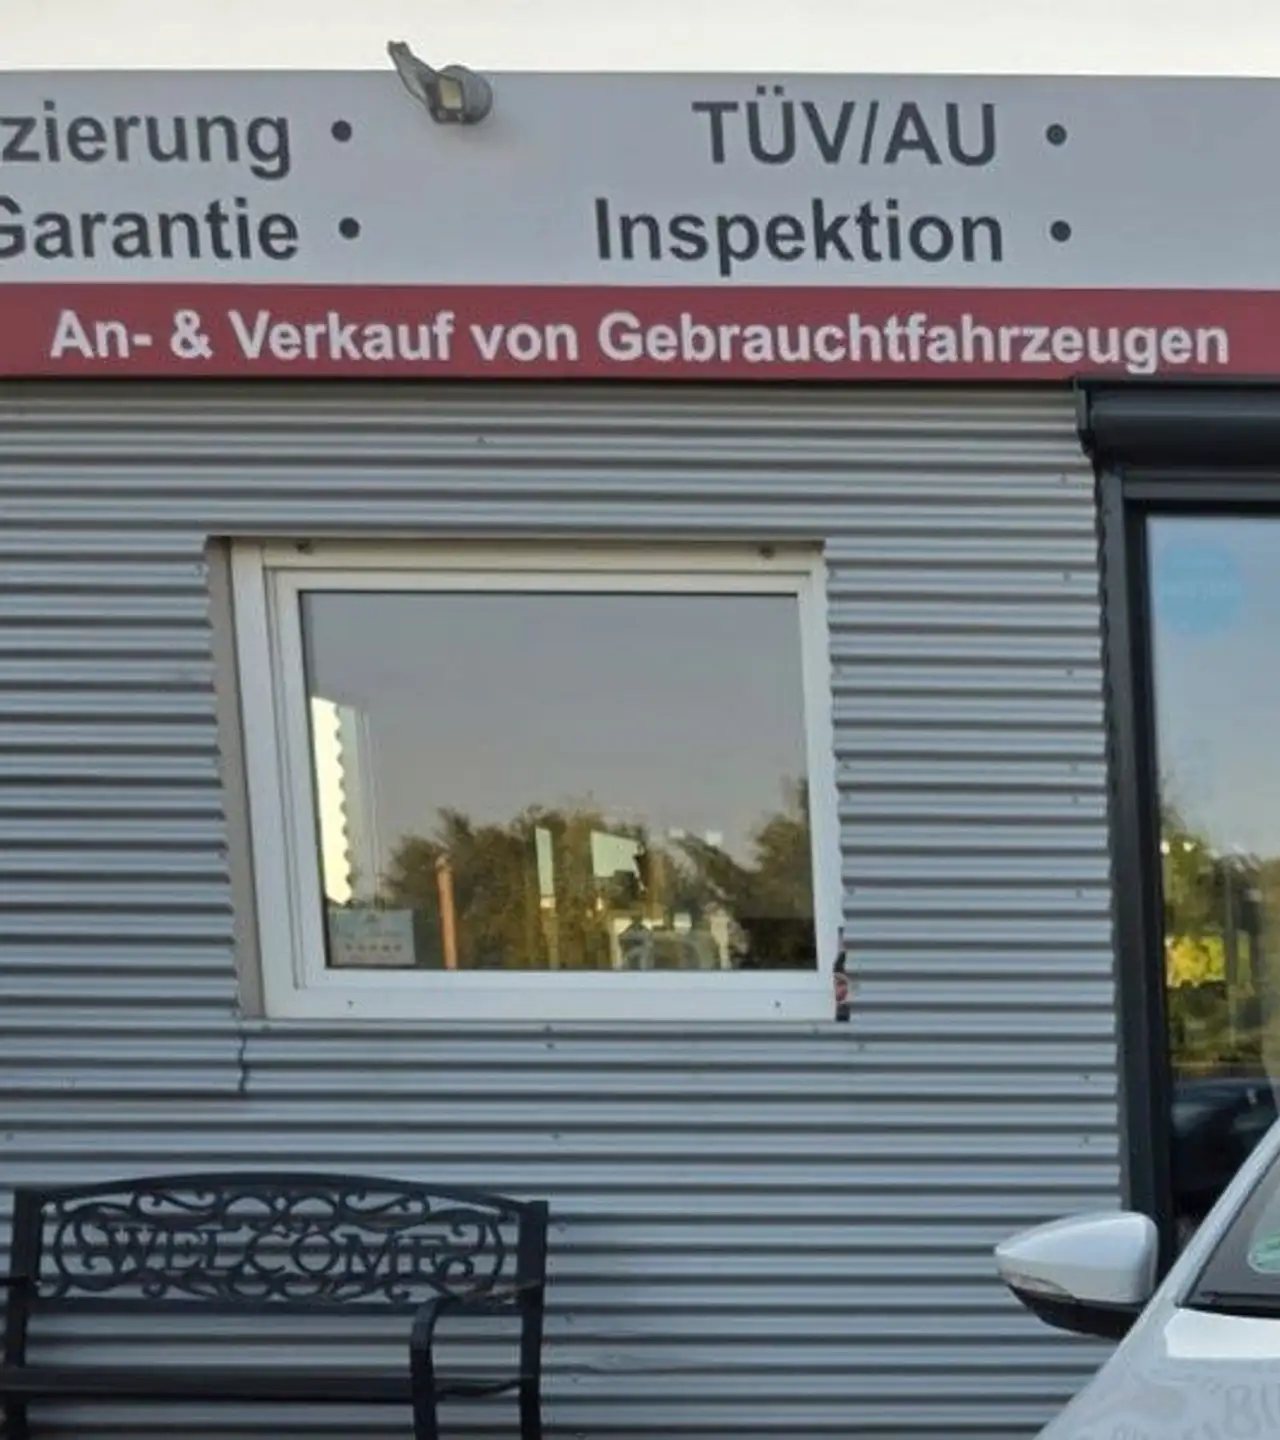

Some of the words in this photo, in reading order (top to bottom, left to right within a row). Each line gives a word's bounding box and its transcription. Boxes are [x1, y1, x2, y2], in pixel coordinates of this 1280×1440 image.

[0, 99, 290, 181] zierung
[691, 84, 997, 167] TÜV/AU
[595, 197, 1003, 277] Inspektion
[50, 309, 152, 358] An-
[170, 309, 213, 359] &
[228, 310, 455, 361] Verkauf
[469, 323, 578, 361] von
[598, 311, 1229, 374] Gebrauchtfahrzeugen
[106, 1224, 450, 1276] WELCOME
